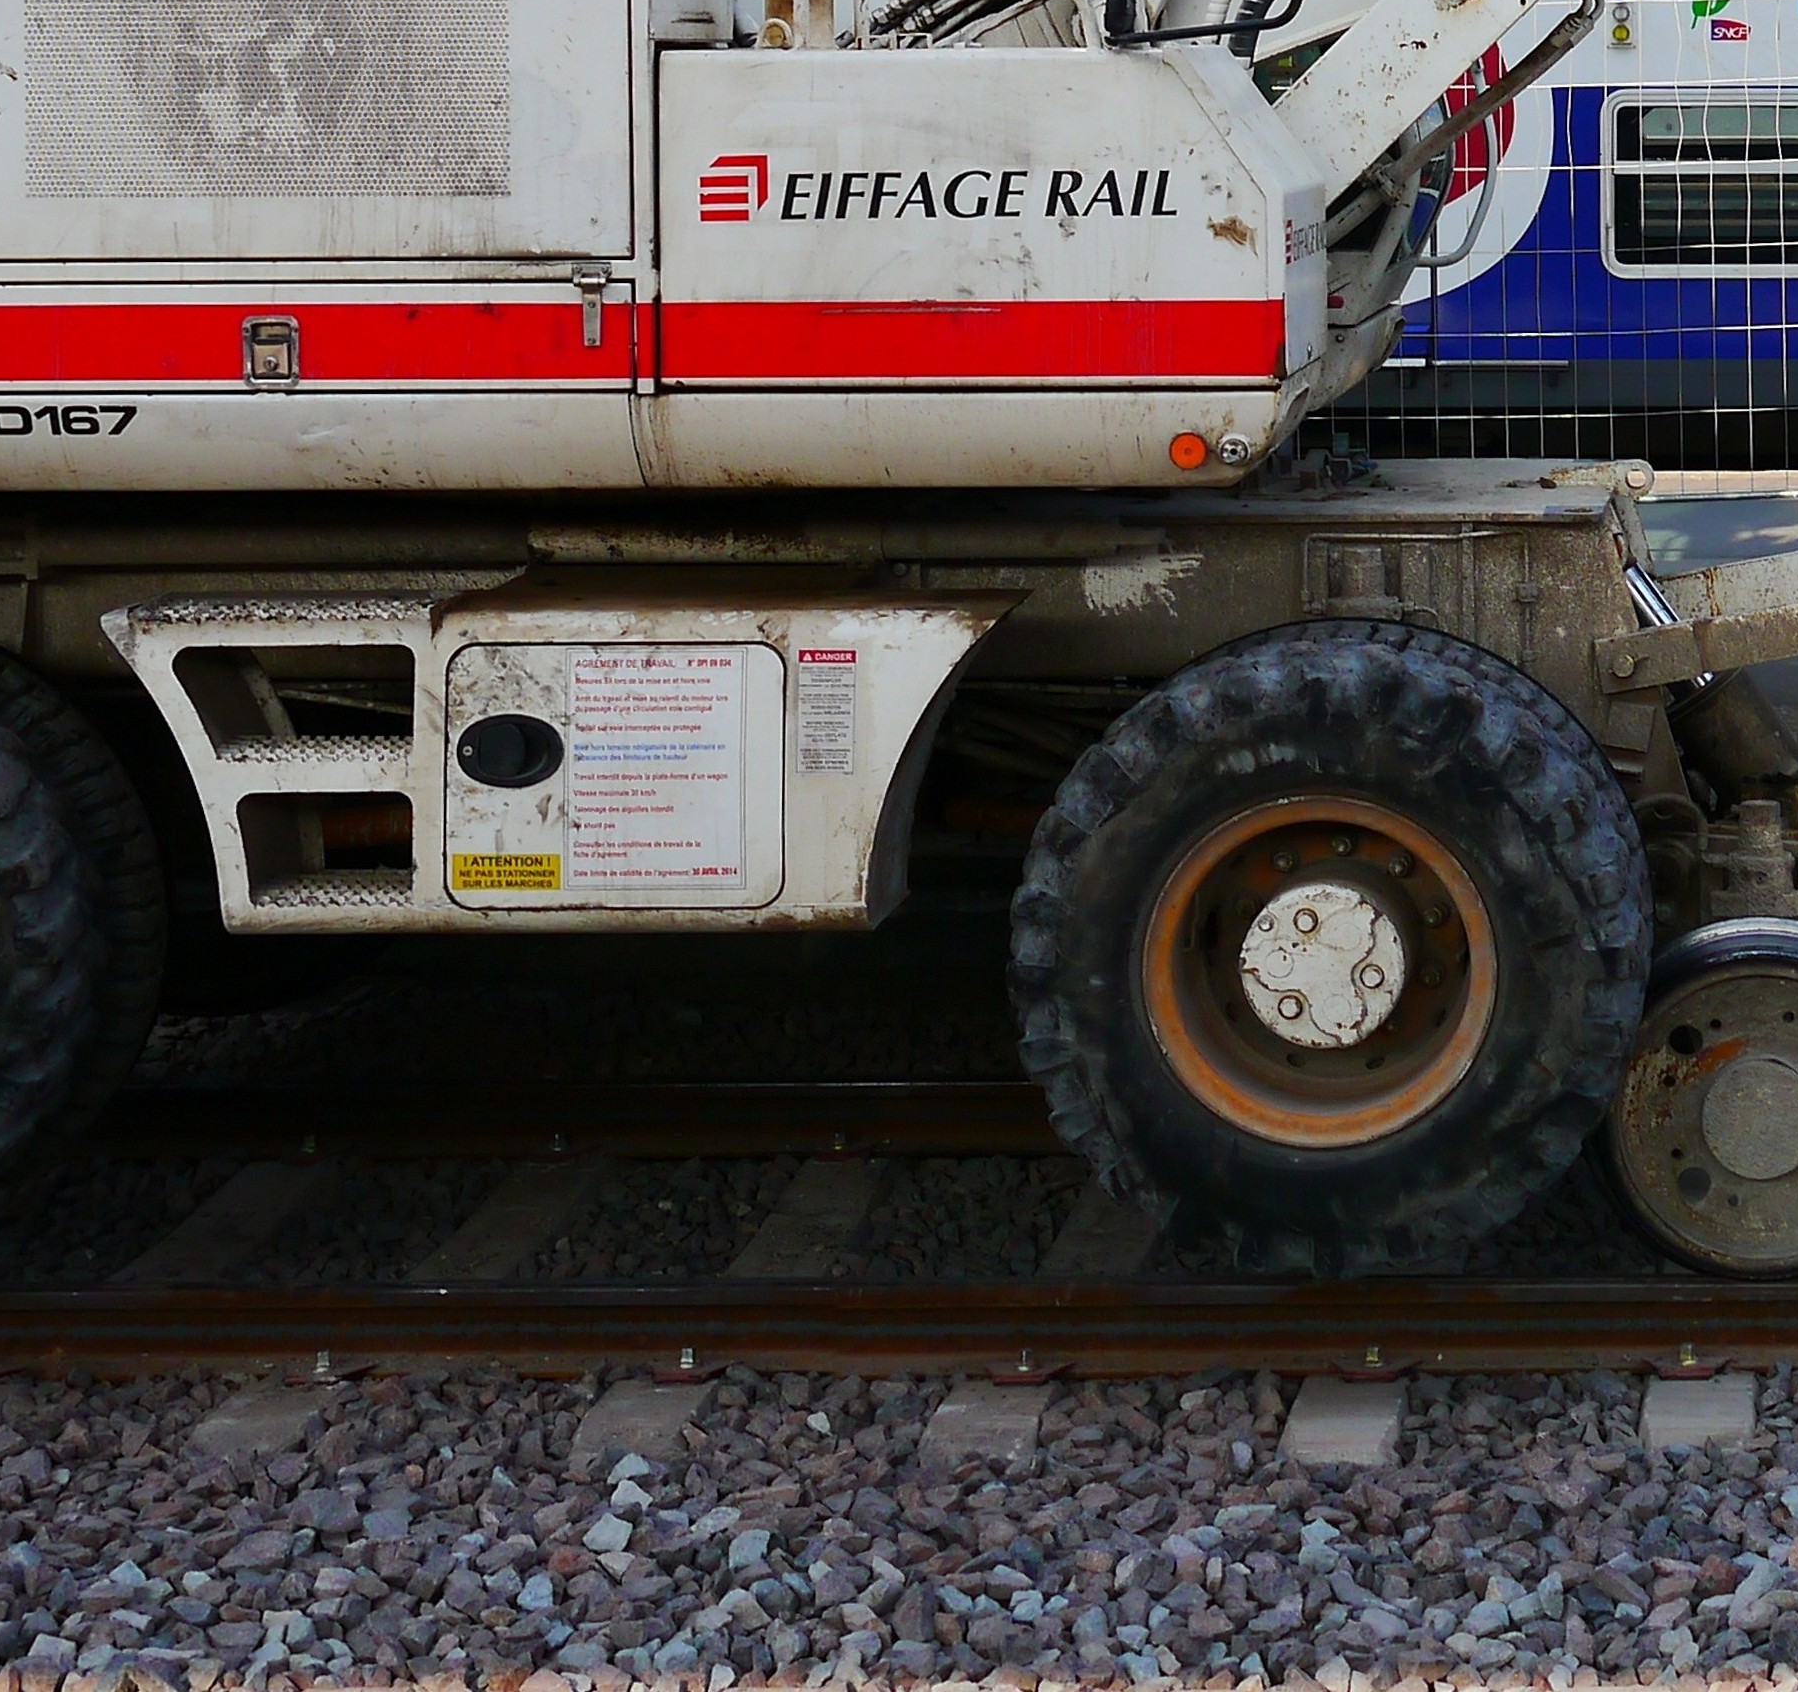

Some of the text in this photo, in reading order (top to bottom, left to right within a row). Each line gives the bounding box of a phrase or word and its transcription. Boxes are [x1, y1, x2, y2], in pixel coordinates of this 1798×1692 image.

[1712, 26, 1748, 39] SNCF
[779, 168, 1179, 221] EIFFAGE RAIL
[814, 652, 854, 661] DANGER
[625, 659, 638, 668] DE
[640, 658, 676, 668] TRAVAIL
[470, 856, 544, 867] ATTENTION
[459, 869, 556, 878] NE PAS STATIONNER
[721, 867, 738, 876] 2014
[462, 879, 553, 888] SUR LES MARCHES
